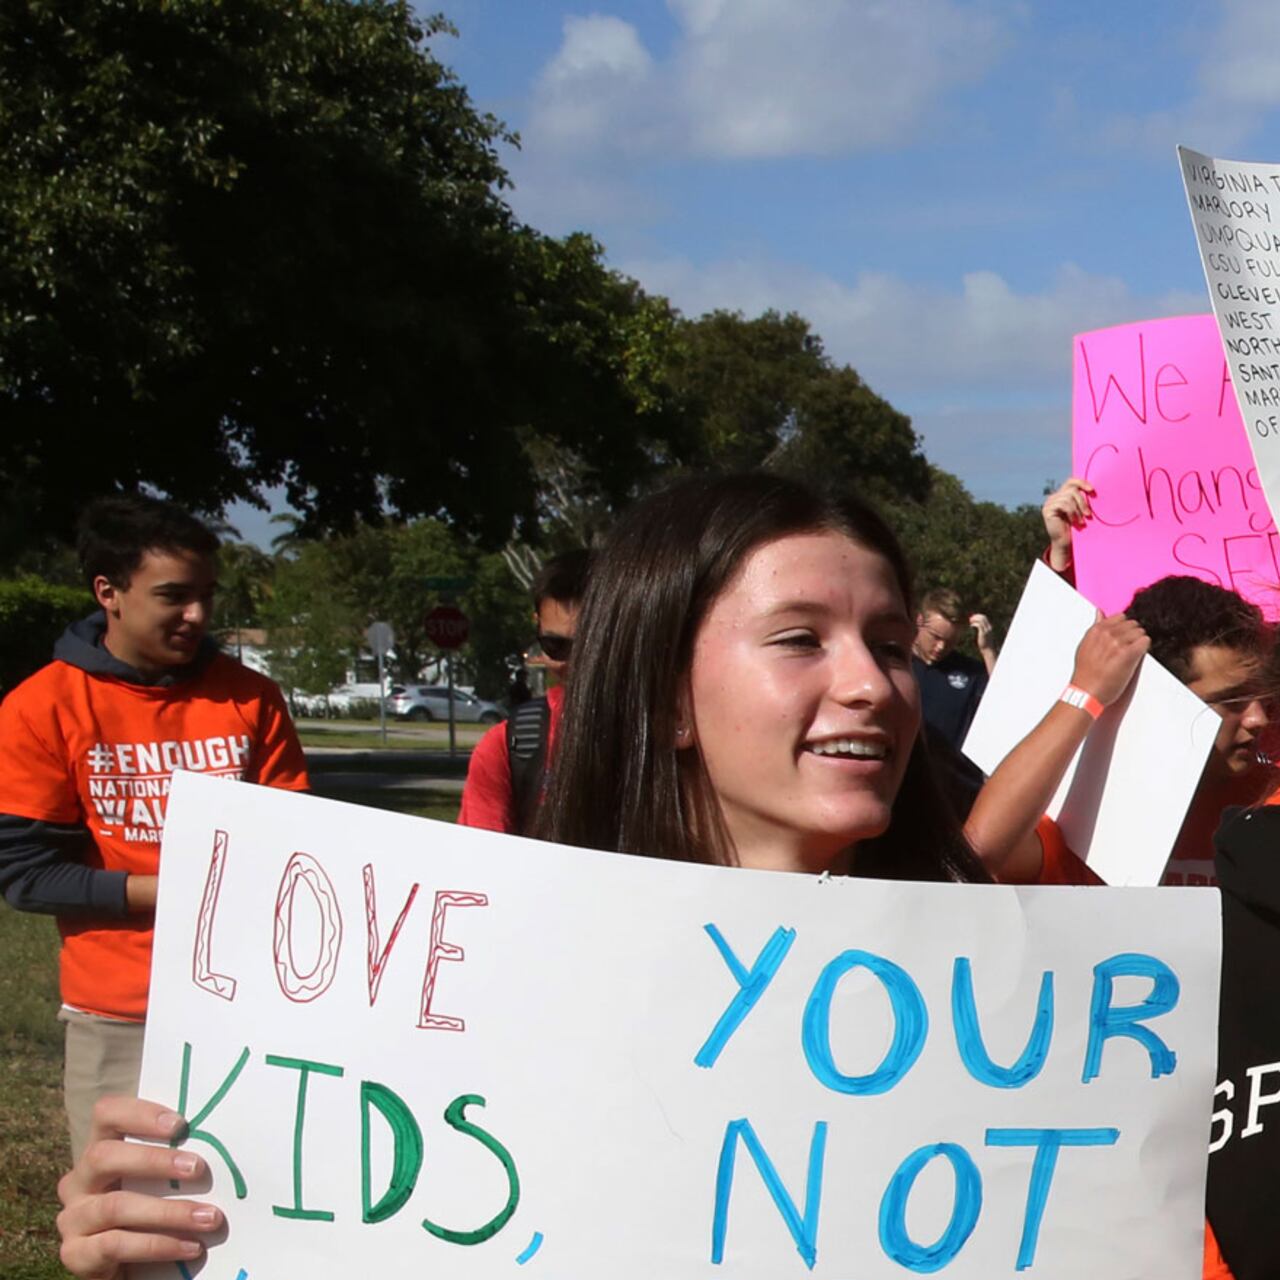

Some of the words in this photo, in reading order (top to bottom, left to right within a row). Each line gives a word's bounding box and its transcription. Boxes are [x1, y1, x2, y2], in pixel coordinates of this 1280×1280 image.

[1188, 165, 1269, 194] VIRGINIA
[1192, 195, 1271, 222] MARJORY
[1208, 252, 1241, 274] CSU
[1224, 311, 1272, 331] WEST
[1080, 333, 1191, 425] We
[1255, 416, 1278, 438] OF
[1084, 443, 1274, 532] Chang
[87, 735, 249, 774] #ENOUGH
[89, 779, 172, 797] NATIONA
[192, 829, 488, 1031] LOVE
[693, 920, 1181, 1097] YOUR
[709, 1117, 1120, 1274] NOT
